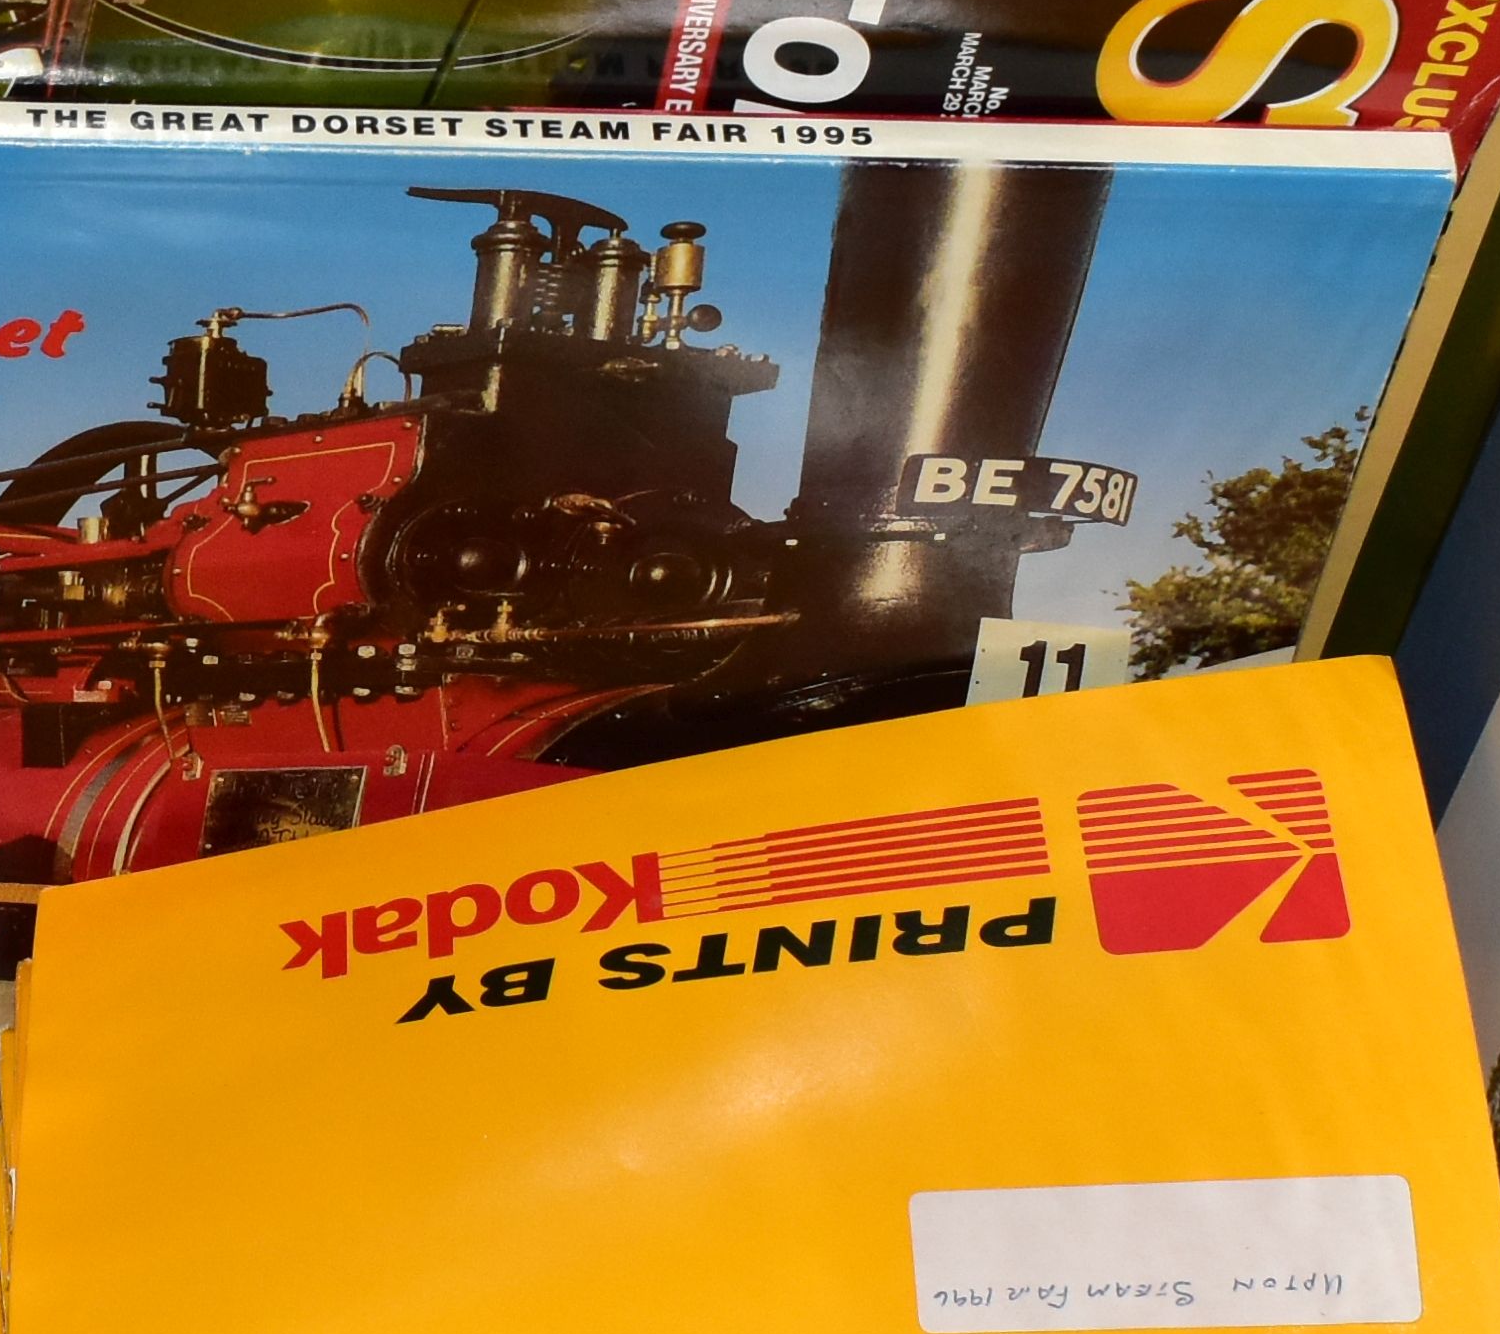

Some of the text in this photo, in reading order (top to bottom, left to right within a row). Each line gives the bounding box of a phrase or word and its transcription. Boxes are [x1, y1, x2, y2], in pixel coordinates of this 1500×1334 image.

[949, 32, 982, 89] MARCH
[26, 108, 874, 146] THE GREAT DORSET STEAM FAIR 1995
[913, 457, 1135, 523] BE 7581
[1018, 639, 1087, 698] 11
[280, 851, 663, 979] Kodak
[394, 896, 1057, 1024] PRINTS BY
[932, 1287, 993, 1307] 1996
[1086, 1279, 1195, 1307] STEAM
[1231, 1273, 1343, 1295] UPTON
